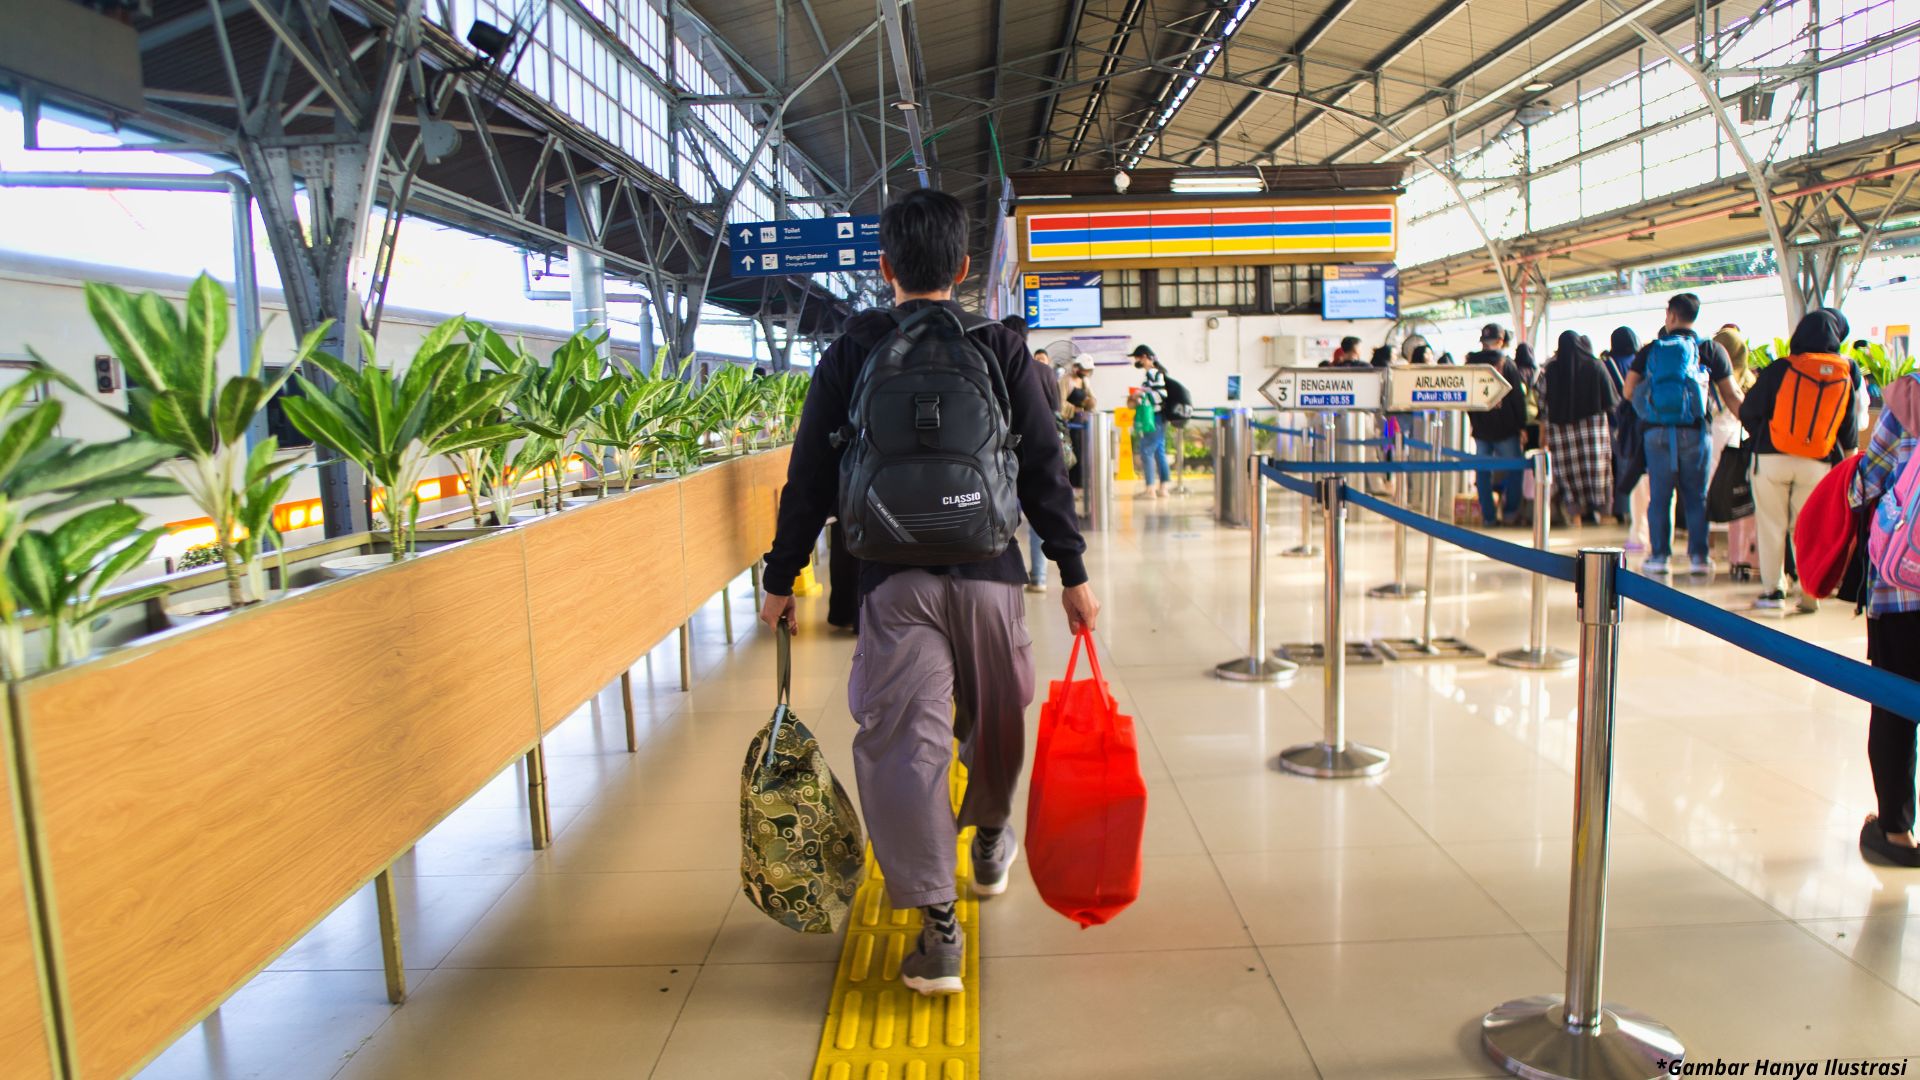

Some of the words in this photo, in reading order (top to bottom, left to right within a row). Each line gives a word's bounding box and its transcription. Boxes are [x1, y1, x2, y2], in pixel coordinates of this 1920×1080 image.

[1028, 305, 1038, 316] 3
[1301, 380, 1353, 391] BENGAWAN
[1416, 376, 1464, 388] AIRLANGGA
[1278, 387, 1288, 401] 3
[1416, 392, 1437, 400] Pukul
[1483, 386, 1489, 397] 4
[1303, 396, 1325, 404] Pukul
[1330, 396, 1350, 404] 08.55
